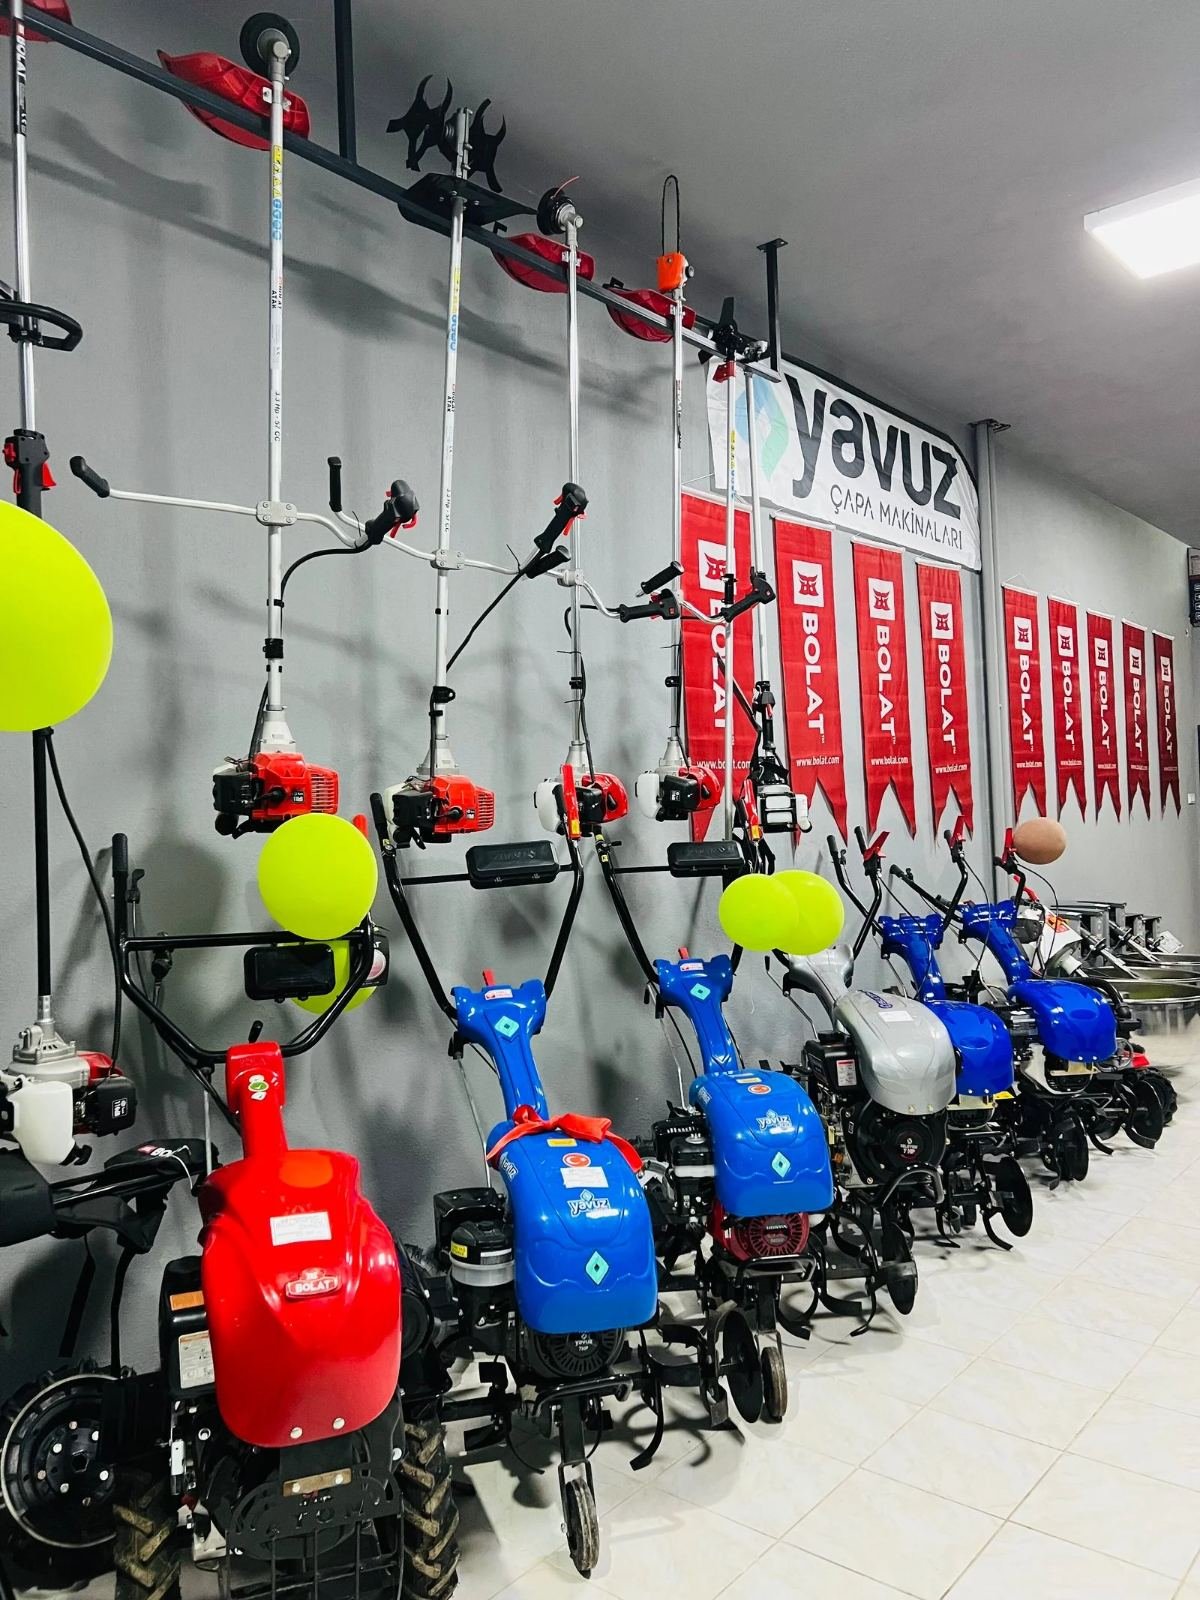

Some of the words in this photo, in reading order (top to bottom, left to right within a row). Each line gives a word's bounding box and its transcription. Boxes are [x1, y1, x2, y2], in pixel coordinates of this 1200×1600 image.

[784, 373, 961, 520] yavuz
[830, 484, 875, 519] ÇAPA
[879, 504, 962, 550] MAKİNALARI
[802, 612, 825, 735] BOLAT
[876, 625, 895, 737] BOLAT
[938, 644, 955, 747] BOLAT
[1019, 654, 1034, 745] BOLAT
[1061, 661, 1074, 745] BOLAT
[1098, 670, 1110, 750] BOLAT
[1132, 677, 1142, 752] BOLAT
[1163, 685, 1173, 754] BOLAT
[796, 756, 840, 767] www.bolat.com
[570, 1199, 608, 1215] yavuz
[295, 1280, 331, 1293] BOLAT
